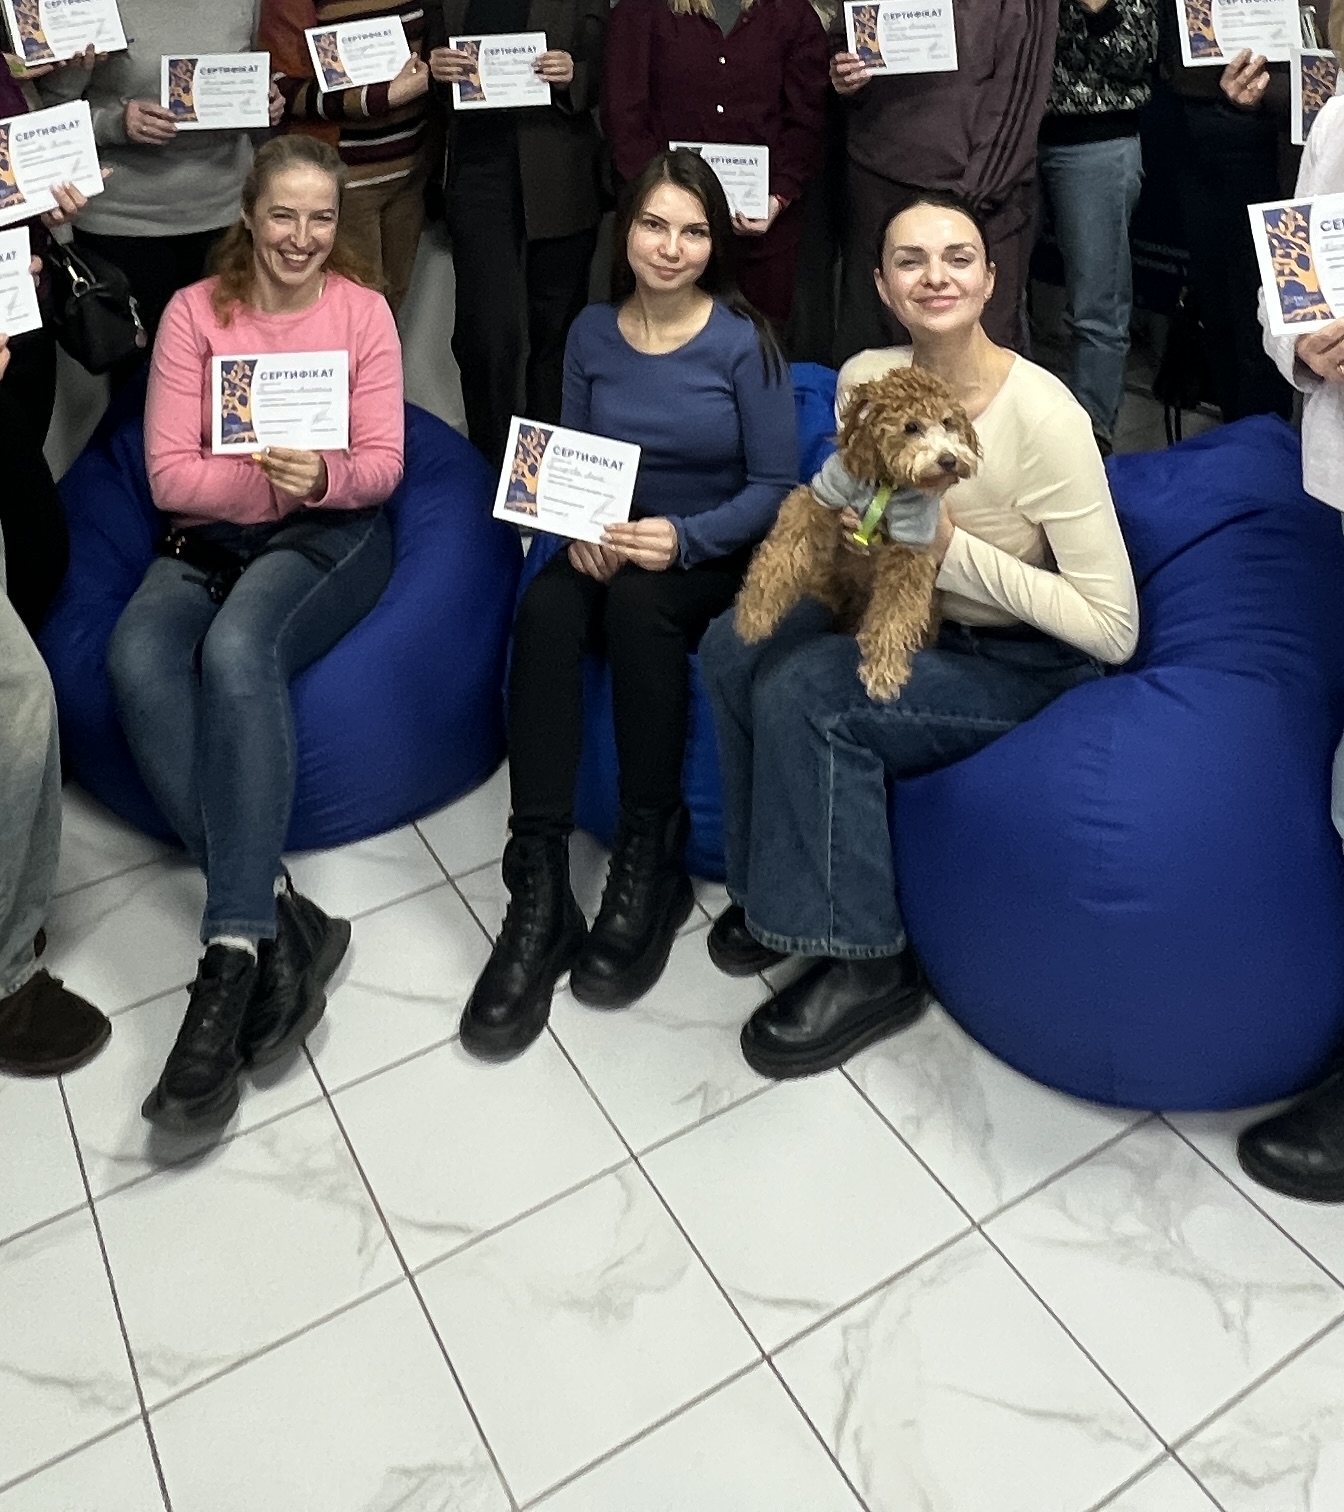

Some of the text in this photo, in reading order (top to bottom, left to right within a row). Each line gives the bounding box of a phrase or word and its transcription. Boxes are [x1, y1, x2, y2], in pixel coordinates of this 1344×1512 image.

[882, 8, 943, 21] СЕРТИФІКАТ
[199, 64, 259, 76] СЕРТИФІКАТ
[15, 119, 80, 142] СЕРТИФІКАТ
[260, 368, 335, 381] СЕРТИФІКАТ
[552, 445, 625, 472] СЕРТИФІКАТ
